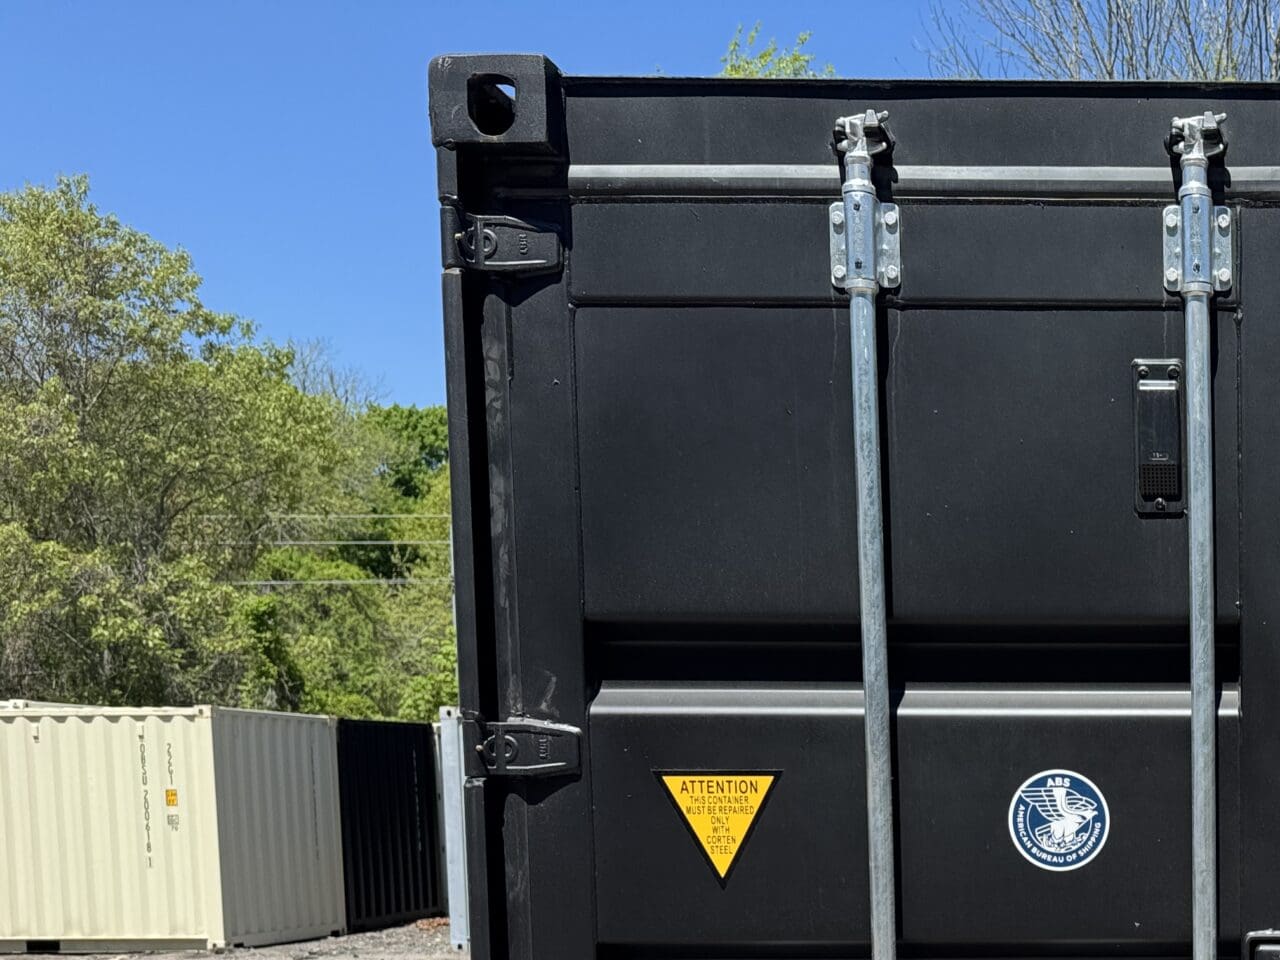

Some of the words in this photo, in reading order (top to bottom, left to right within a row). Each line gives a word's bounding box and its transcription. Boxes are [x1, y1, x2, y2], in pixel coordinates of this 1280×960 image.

[680, 780, 759, 794] ATTENTION
[1046, 777, 1071, 788] ABS
[690, 796, 706, 804] THIS
[708, 796, 749, 804] CONTAINER
[686, 806, 706, 815] MUST
[708, 806, 717, 815] BE
[719, 806, 755, 815] REPAIRED
[710, 816, 730, 825] ONLY
[712, 826, 730, 834] WITH
[1016, 803, 1034, 850] AMERICAN
[1031, 846, 1065, 863] BUREAU
[1066, 852, 1078, 862] OF
[1078, 822, 1102, 857] SHIPPING
[706, 836, 737, 844] CORTEN
[710, 845, 733, 855] STEEL
